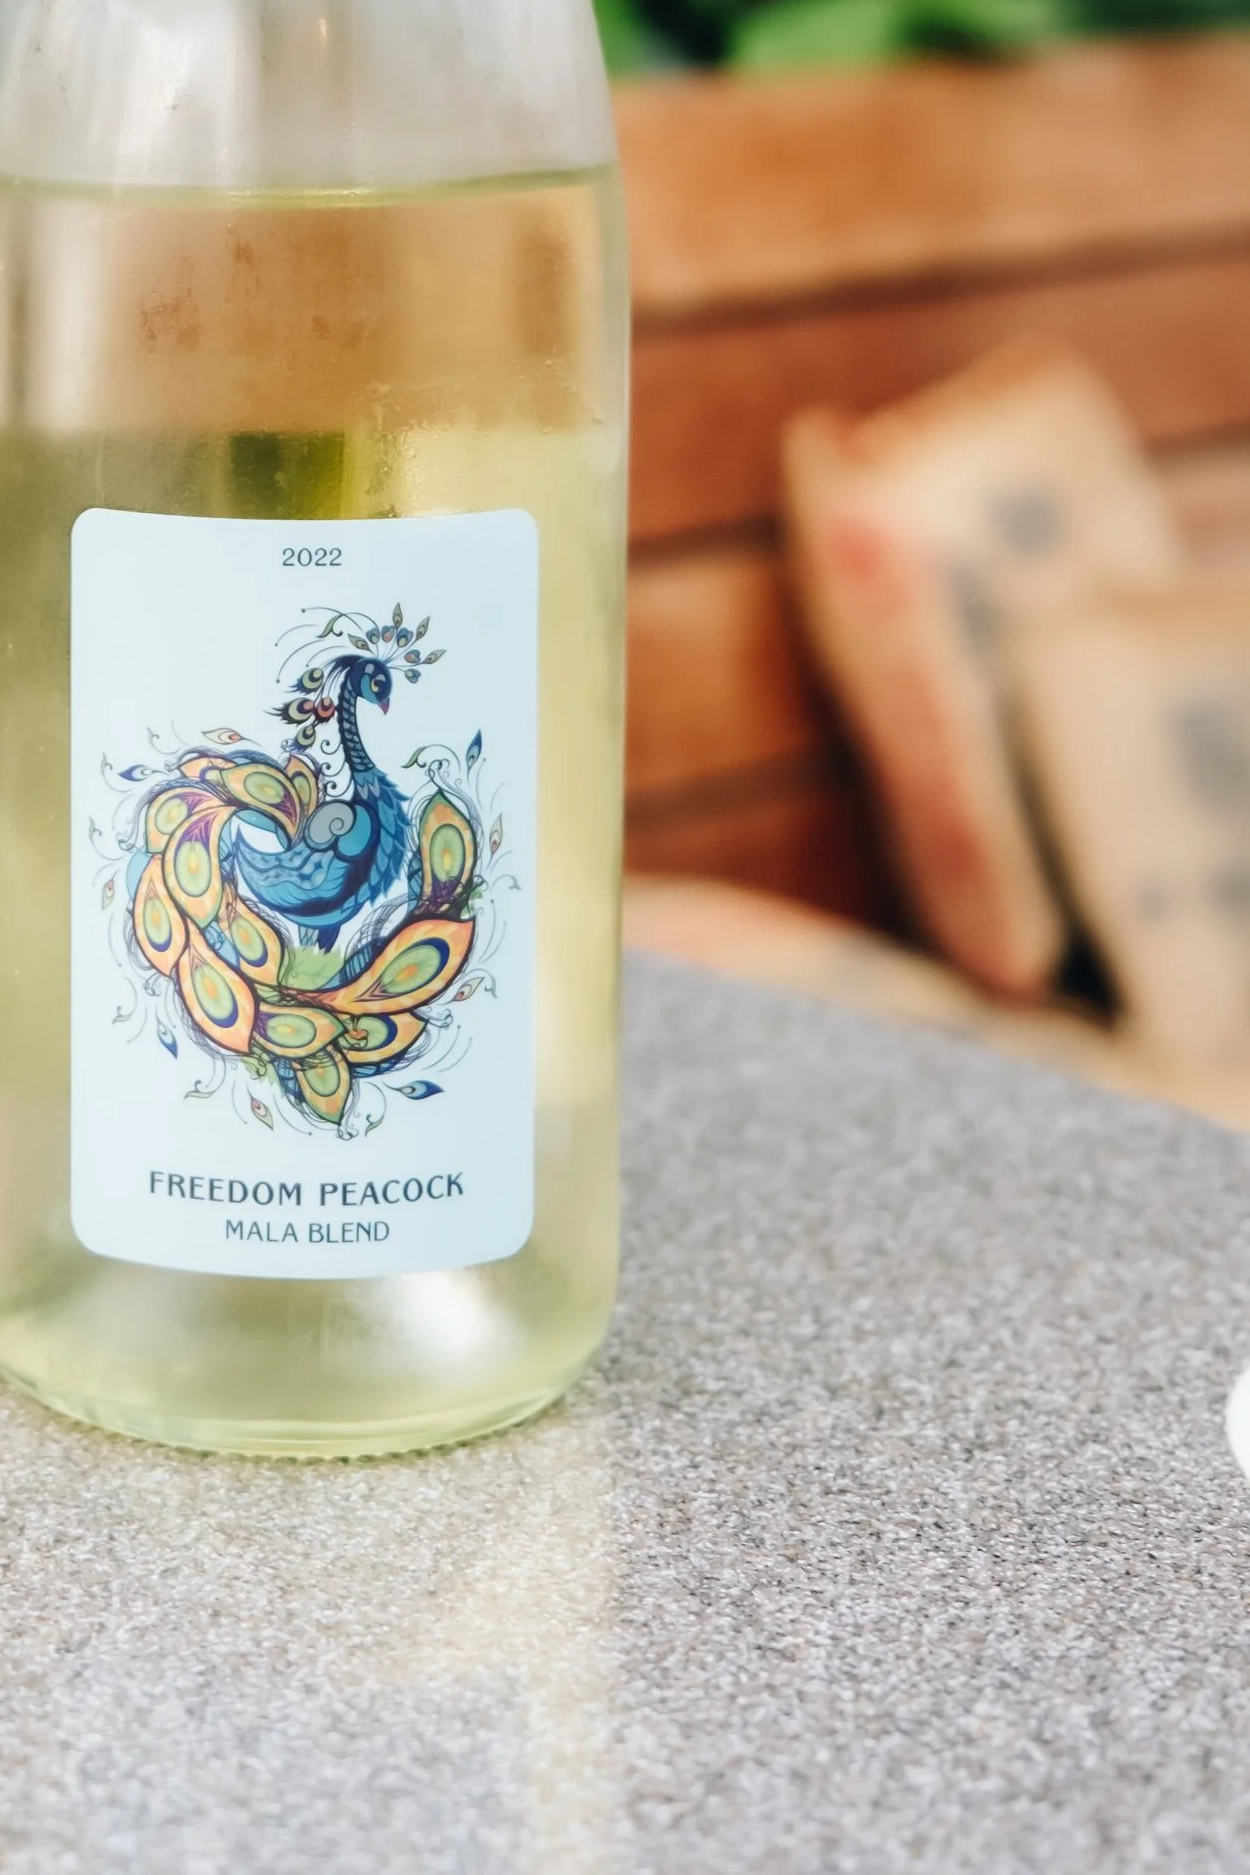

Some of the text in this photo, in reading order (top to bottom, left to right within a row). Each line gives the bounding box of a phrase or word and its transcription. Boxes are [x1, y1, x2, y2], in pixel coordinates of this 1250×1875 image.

[281, 547, 342, 567] 2022
[149, 1170, 465, 1207] FREEDOM PEACOCK
[224, 1219, 390, 1244] MALA BLEND
